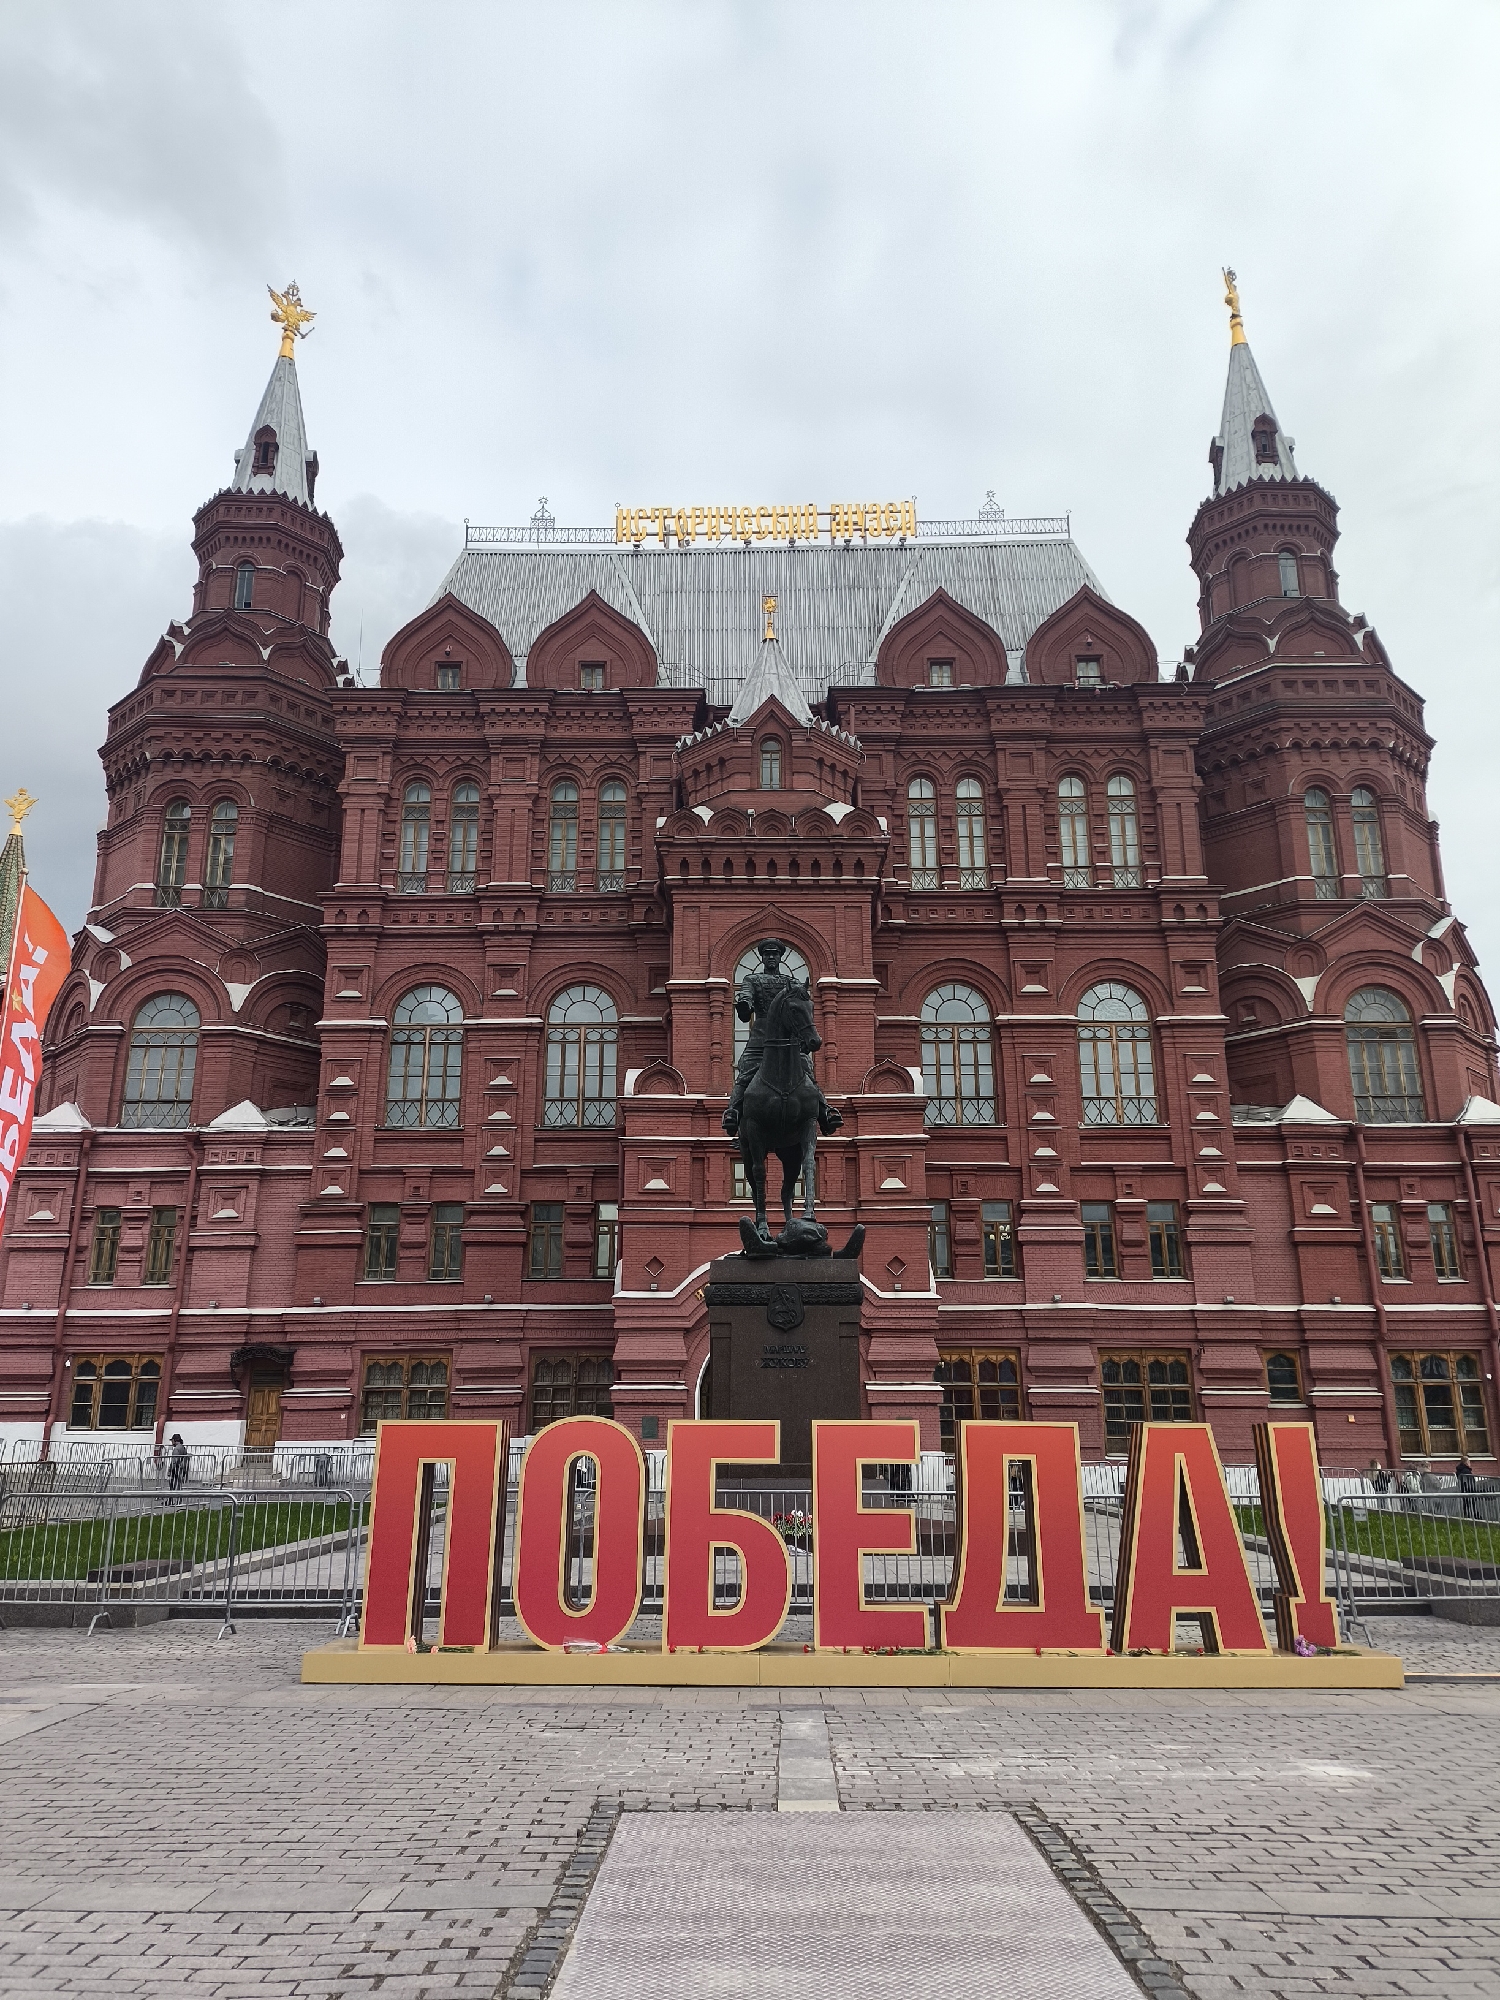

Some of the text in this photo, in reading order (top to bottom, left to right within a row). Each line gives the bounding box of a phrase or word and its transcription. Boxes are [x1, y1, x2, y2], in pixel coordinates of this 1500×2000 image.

[617, 501, 916, 543] ИСТОРИЧЕСКИЙ МУЗЕЙ
[358, 1414, 1341, 1656] ПОБЕДА!
